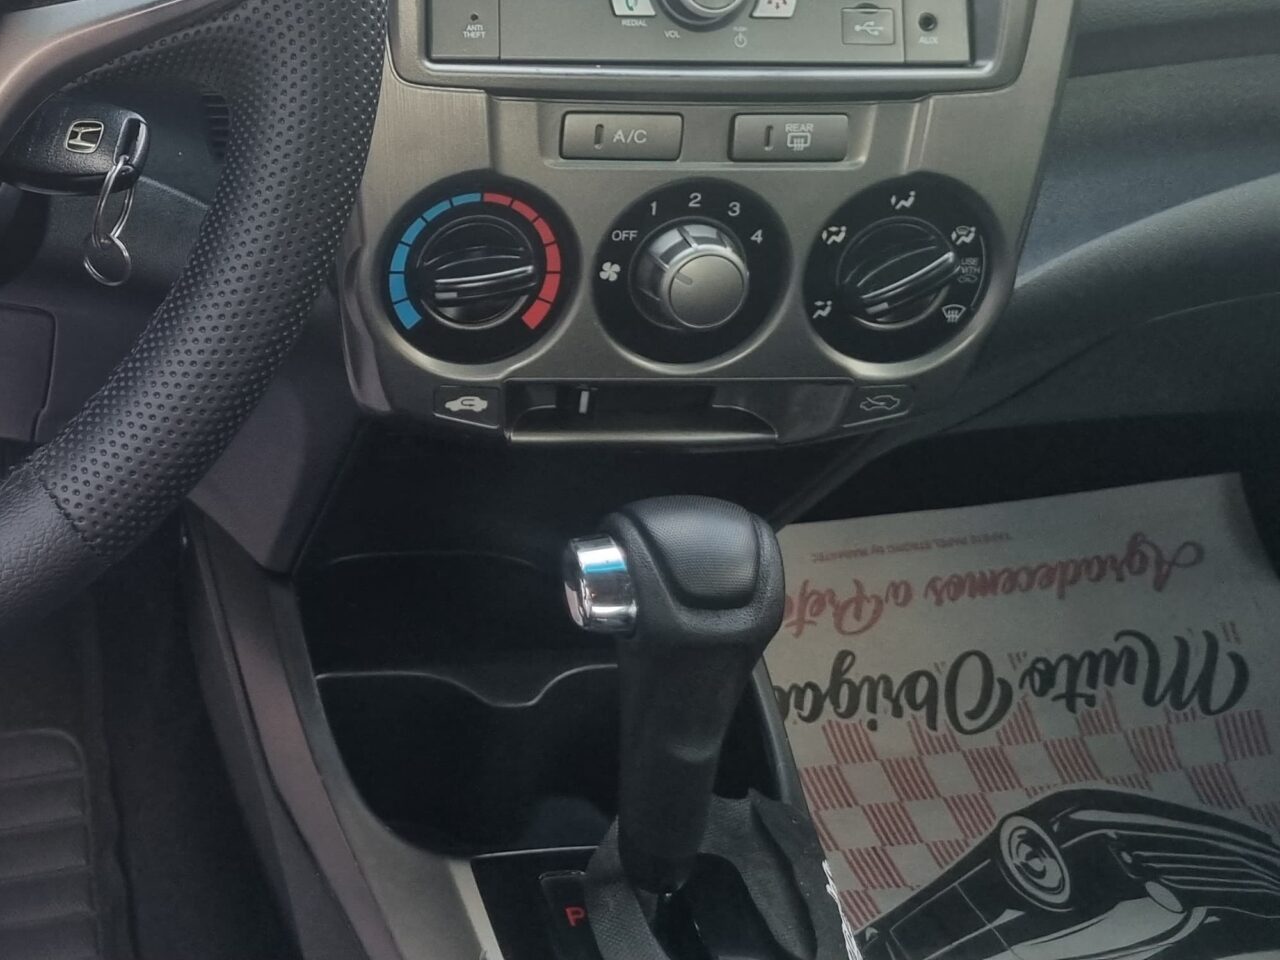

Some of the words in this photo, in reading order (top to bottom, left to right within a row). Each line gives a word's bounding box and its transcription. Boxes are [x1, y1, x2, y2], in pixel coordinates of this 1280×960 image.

[621, 19, 648, 27] REDIAL
[664, 30, 680, 39] VOL
[785, 123, 813, 132] REAR
[613, 130, 647, 144] A/C
[688, 193, 702, 208] 2
[650, 201, 658, 216] 1
[728, 202, 741, 216] 3
[611, 231, 638, 241] OFF
[750, 229, 763, 243] 4
[924, 533, 1203, 604] Agradecemos
[885, 580, 913, 607] a
[1020, 629, 1249, 716] Muito
[565, 906, 586, 927] P
